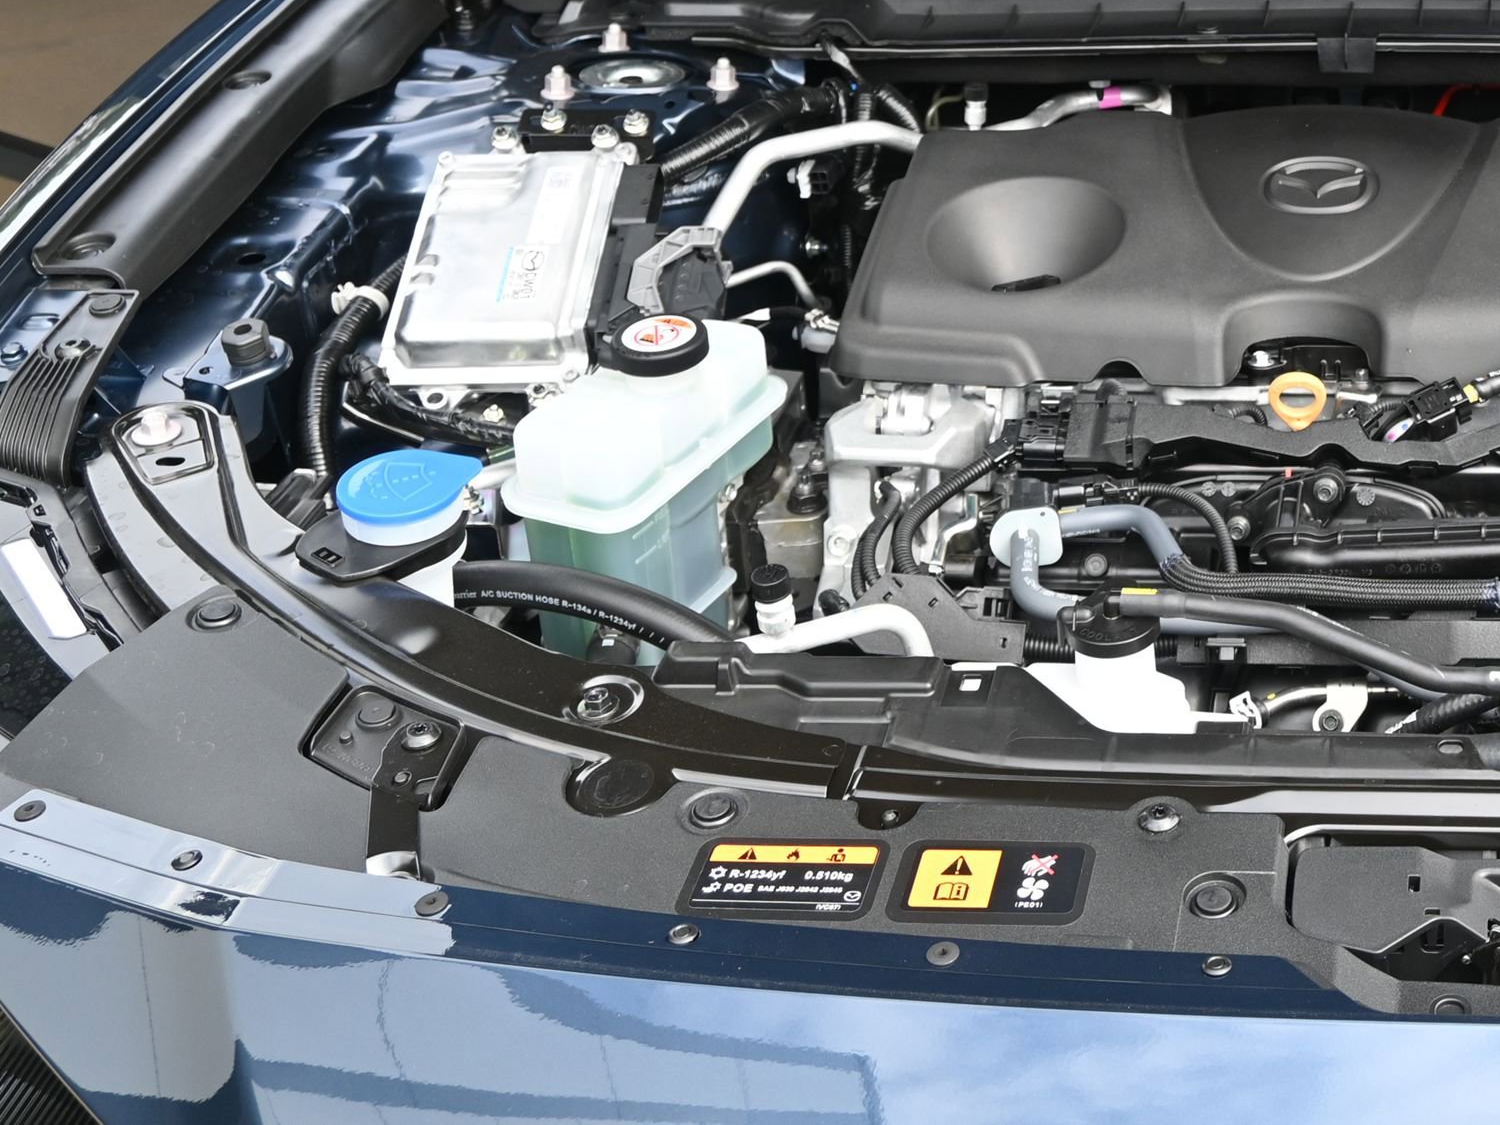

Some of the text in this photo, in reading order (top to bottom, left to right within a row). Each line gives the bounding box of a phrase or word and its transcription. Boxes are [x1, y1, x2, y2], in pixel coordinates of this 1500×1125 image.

[480, 590, 495, 598] A/C
[496, 590, 534, 601] SUCTION
[535, 595, 560, 606] HOSE
[562, 599, 592, 614] R-134a
[598, 611, 637, 631] R-1234yf
[728, 869, 854, 882] R-1234yf 0.510kg
[723, 883, 754, 893] POE
